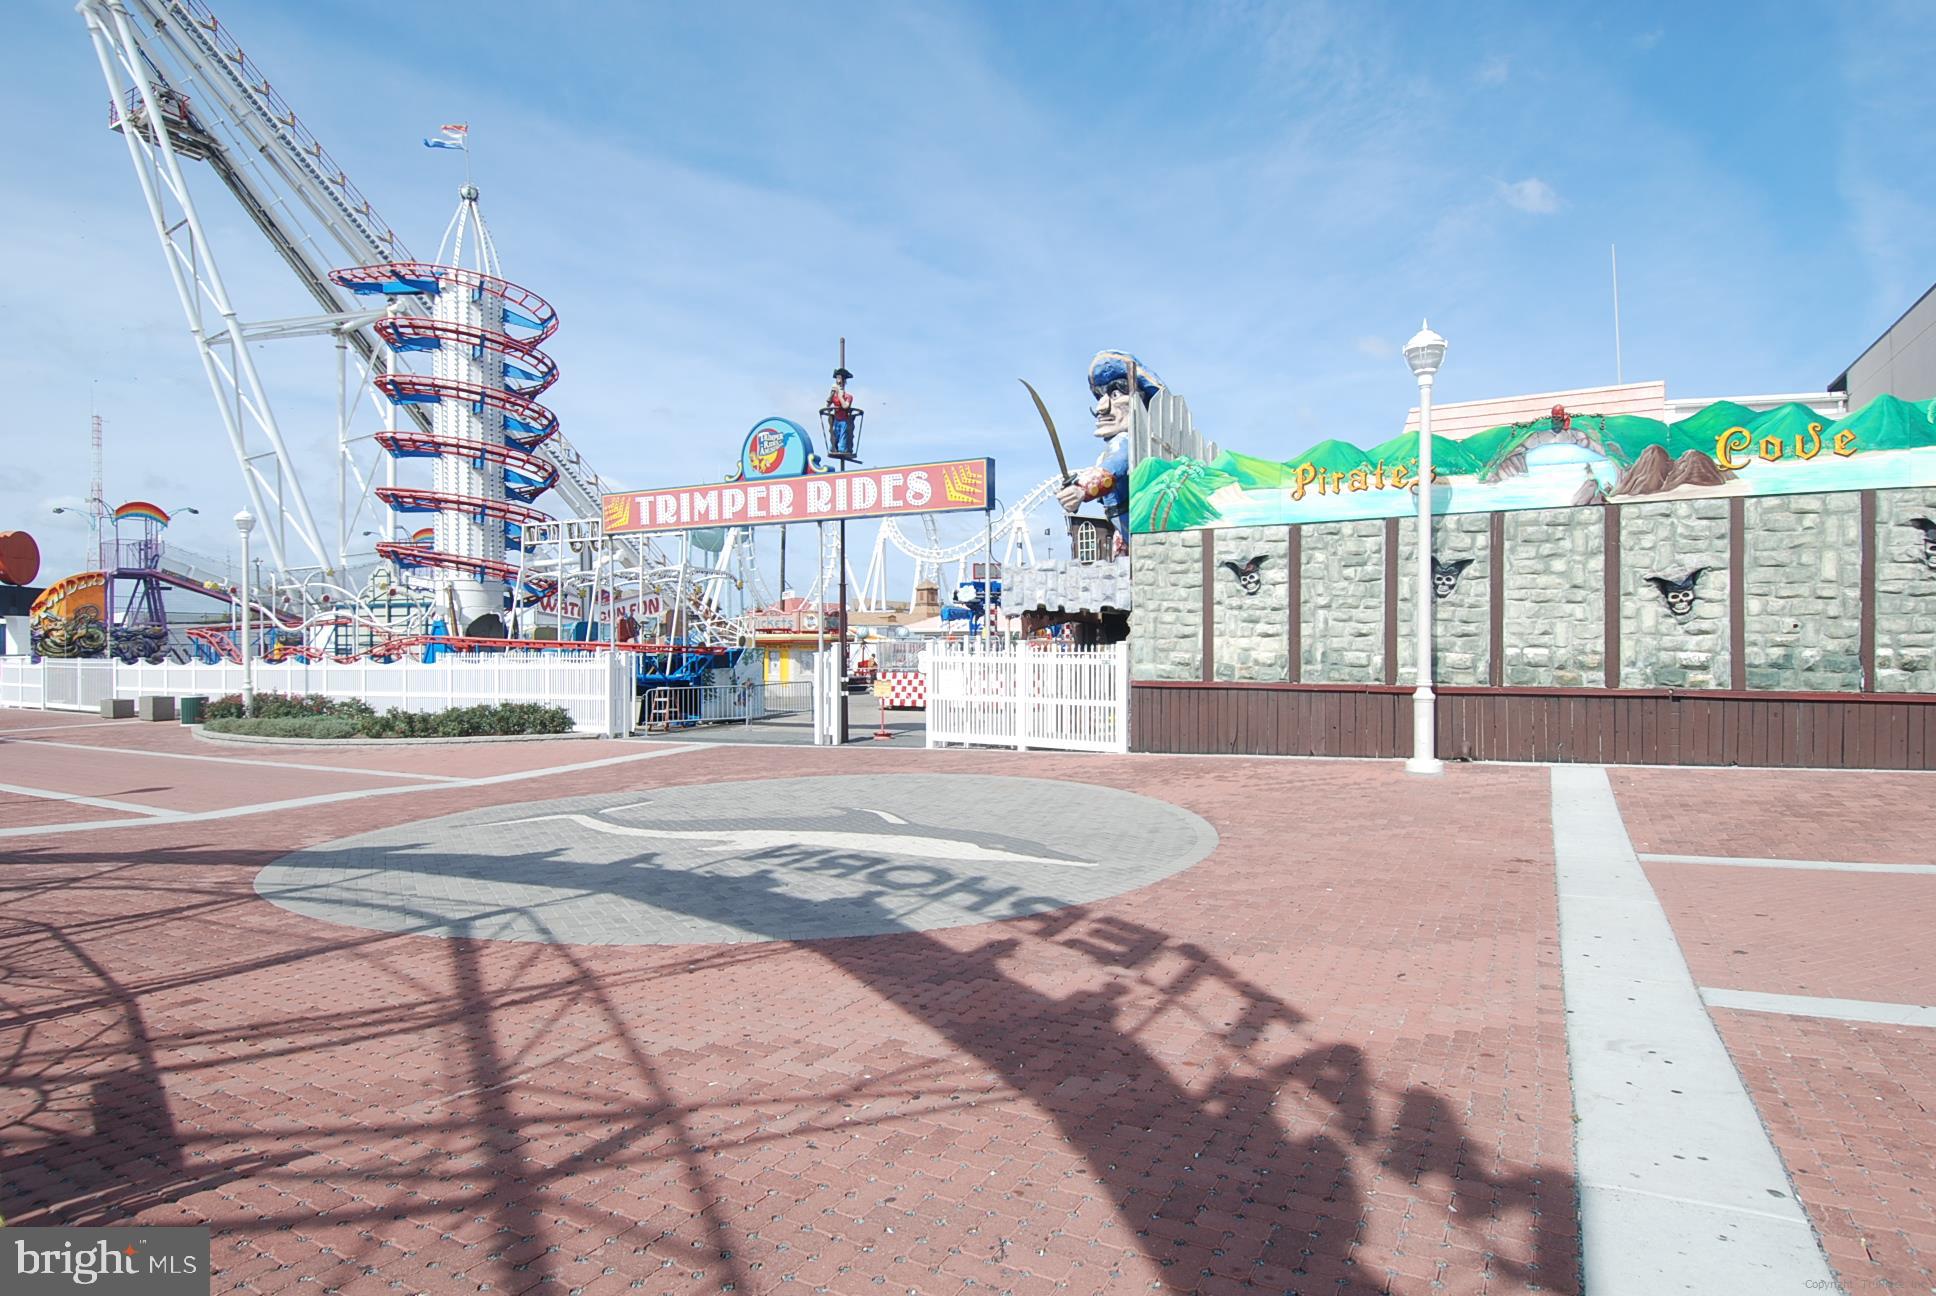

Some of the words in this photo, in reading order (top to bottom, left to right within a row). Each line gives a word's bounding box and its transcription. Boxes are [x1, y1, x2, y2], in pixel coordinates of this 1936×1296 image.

[1715, 422, 1858, 471] Cove
[635, 483, 794, 526] TRIMPER
[806, 470, 932, 515] RIDES
